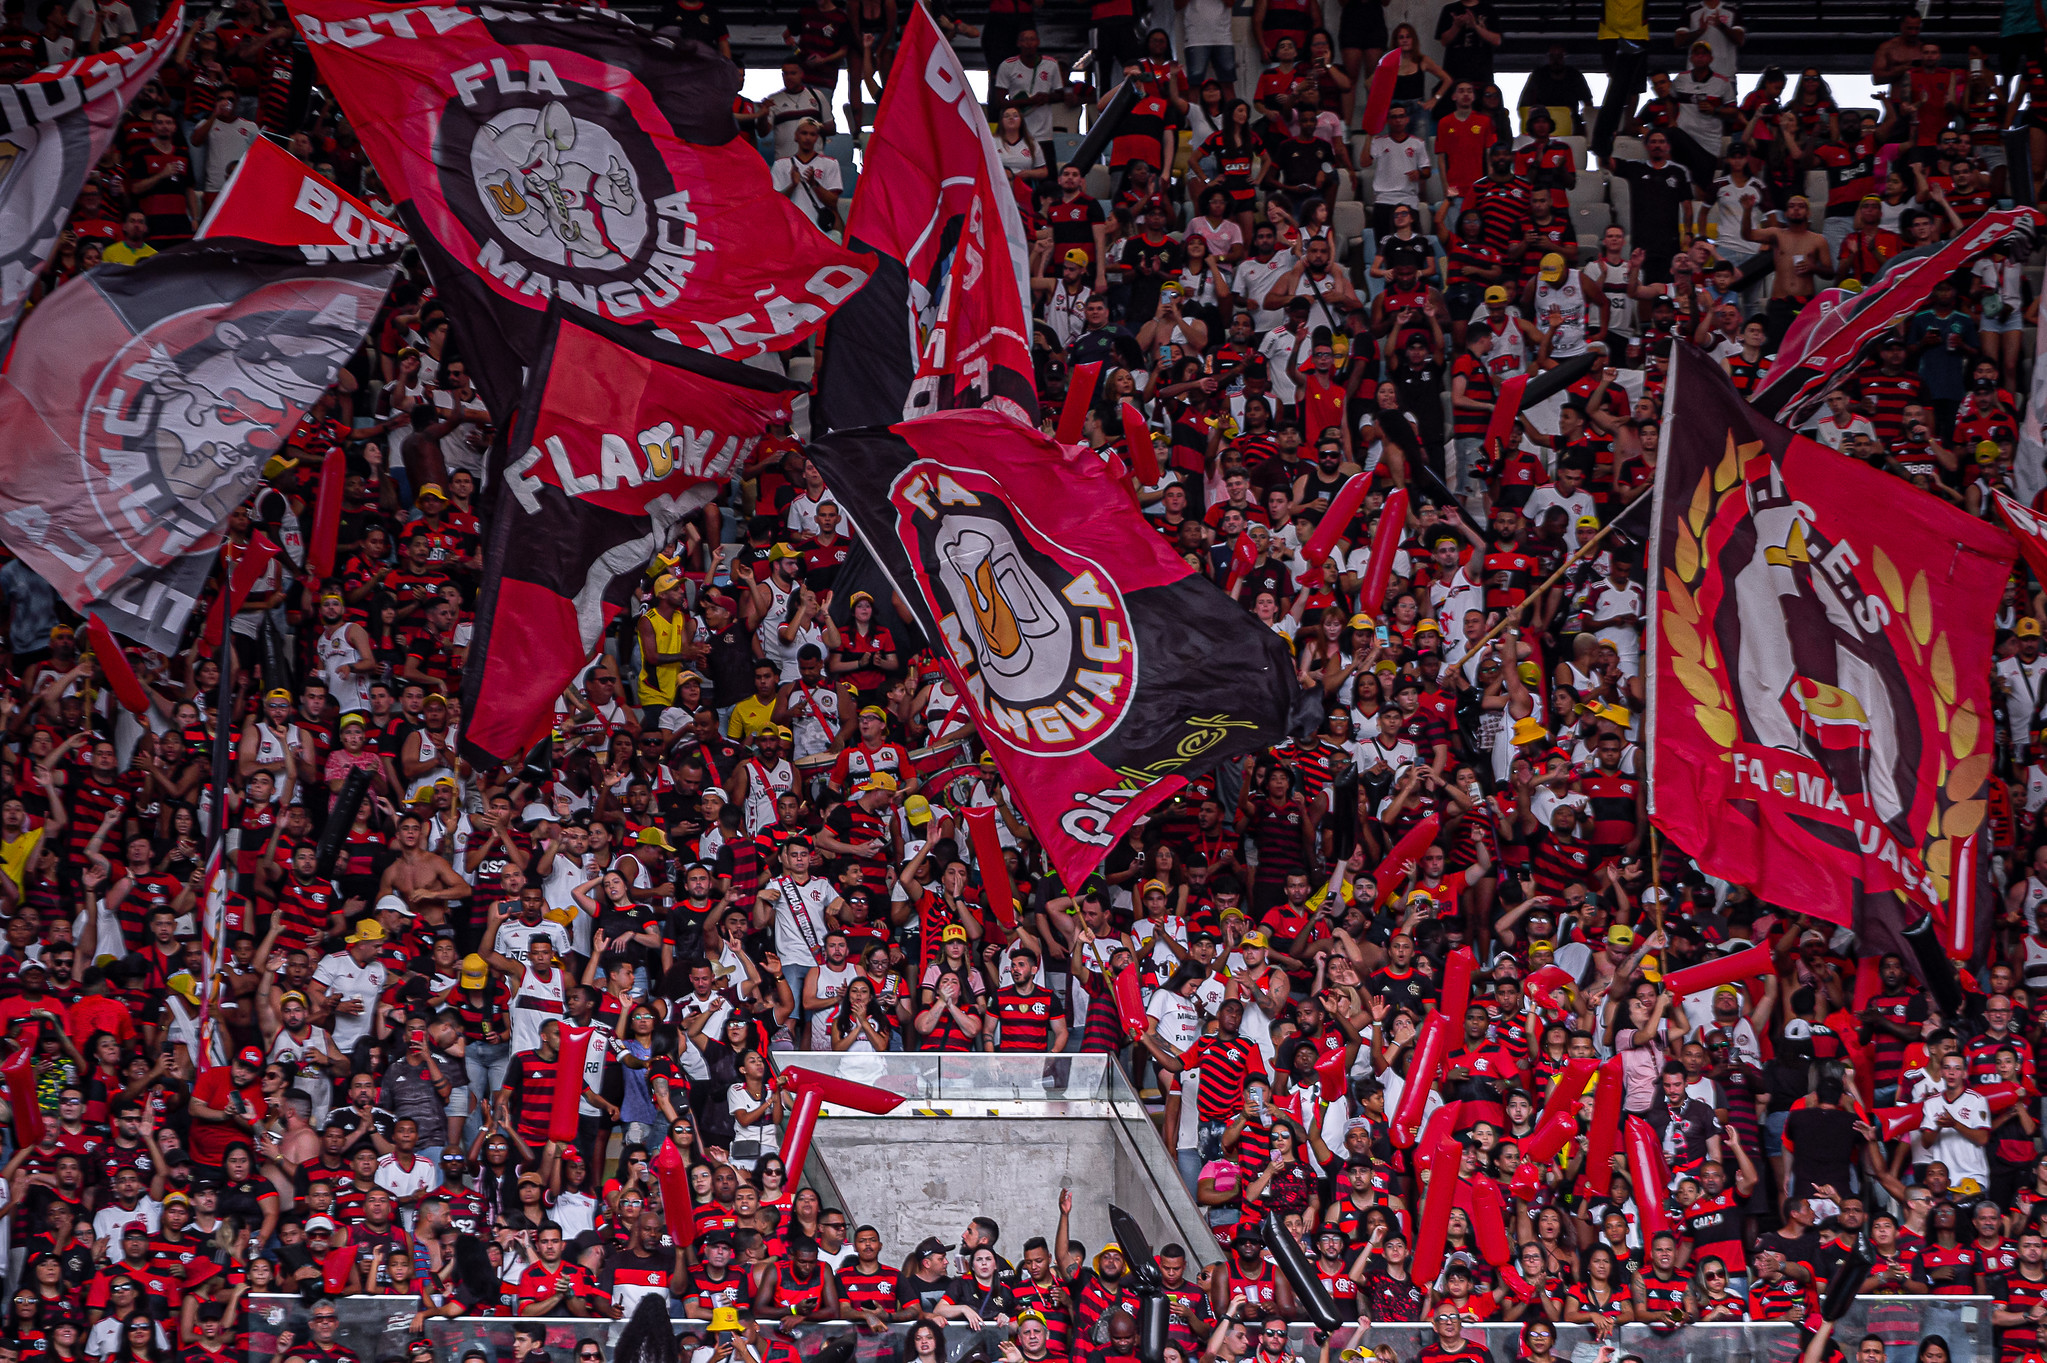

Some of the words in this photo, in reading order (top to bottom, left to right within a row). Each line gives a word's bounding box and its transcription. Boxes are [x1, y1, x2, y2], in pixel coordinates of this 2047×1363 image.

[450, 56, 568, 108] FLA
[476, 189, 715, 318] MANGUAÇA
[502, 433, 644, 515] FLA
[1909, 464, 1933, 475] BRB
[938, 569, 1133, 744] MANGUAÇA
[585, 1061, 600, 1073] RB
[1979, 1073, 2003, 1085] CAI
[1692, 1212, 1724, 1230] CAIXA
